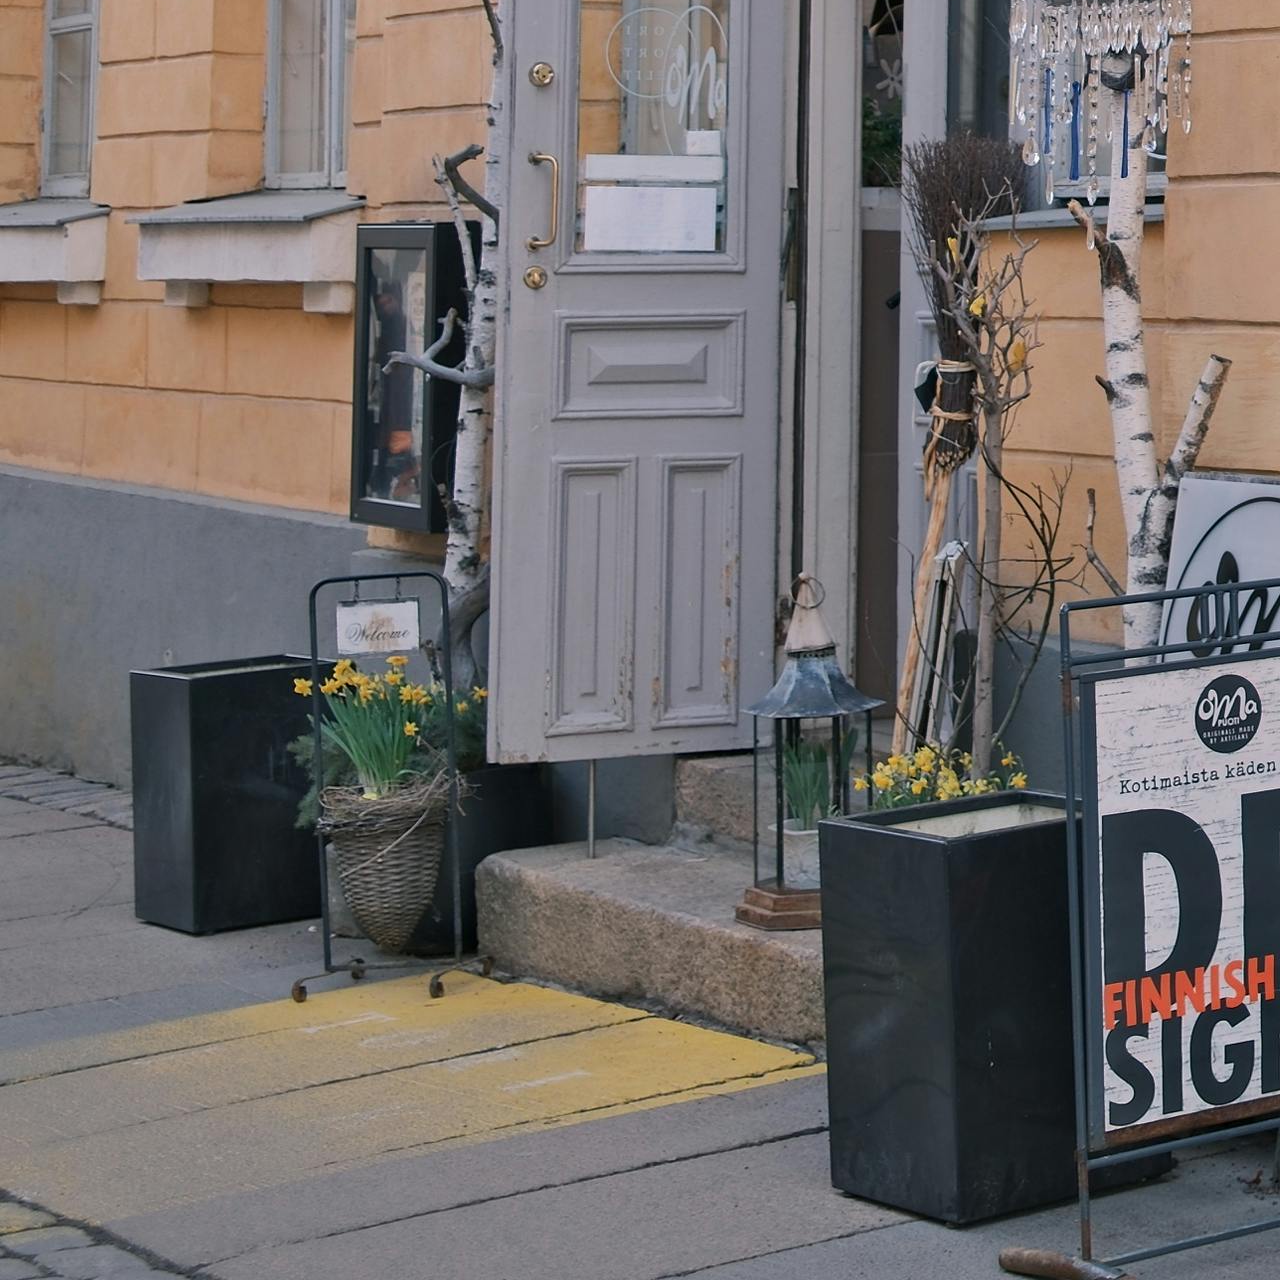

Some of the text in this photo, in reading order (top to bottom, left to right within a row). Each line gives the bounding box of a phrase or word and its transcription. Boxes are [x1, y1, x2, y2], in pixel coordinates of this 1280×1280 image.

[346, 621, 410, 645] Welcome
[1218, 717, 1240, 727] PUOTI
[1119, 768, 1220, 795] Kotimaista
[1225, 761, 1277, 779] käden
[1103, 954, 1276, 1031] FINNISH
